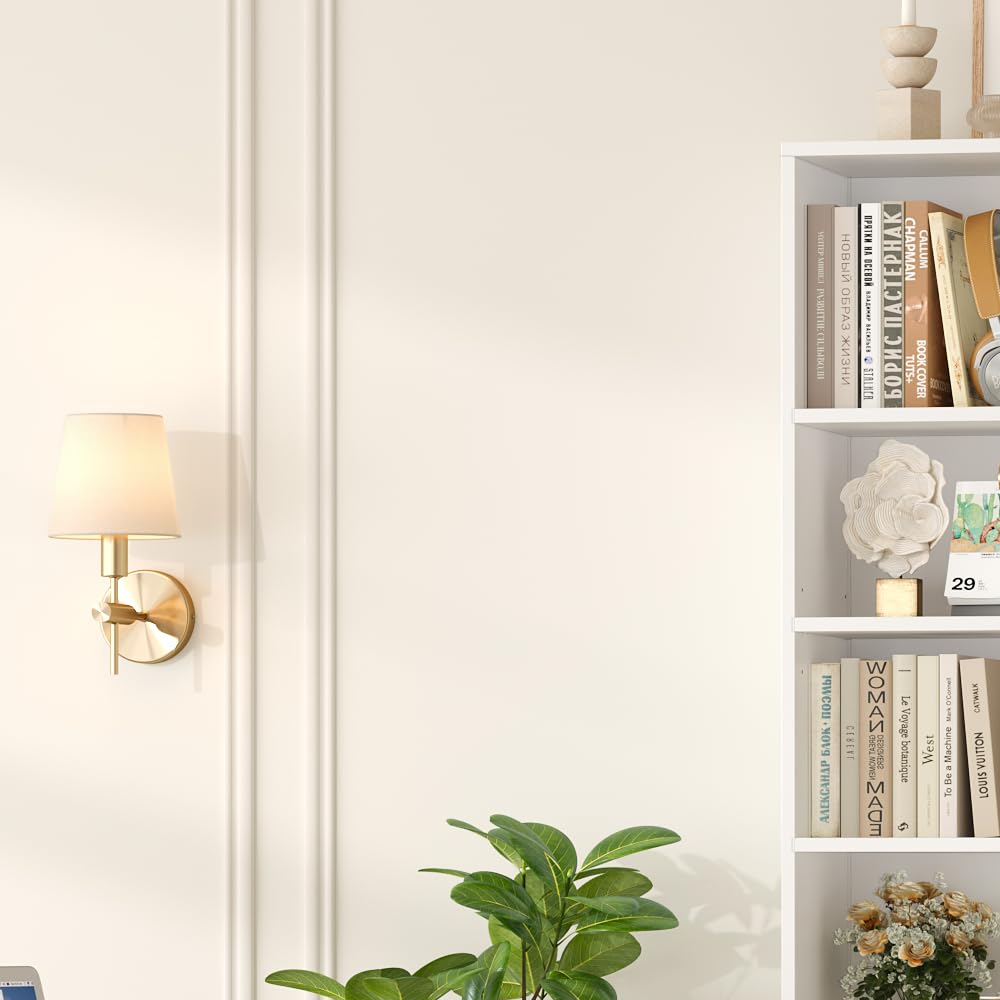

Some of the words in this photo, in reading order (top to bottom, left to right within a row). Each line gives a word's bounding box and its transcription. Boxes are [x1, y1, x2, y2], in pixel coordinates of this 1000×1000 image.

[863, 215, 874, 243] ПРЯТКИ
[841, 233, 852, 283] НОВЫЙ
[863, 246, 874, 256] НА
[904, 217, 917, 281] CHAPMAN
[918, 229, 929, 269] CALLUM
[863, 259, 874, 287] ОСЕВОЙ
[883, 211, 902, 329] ПАСТЕРНАК
[841, 287, 852, 330] ОБРАЗ
[841, 335, 852, 386] ЖИЗНИ
[883, 335, 902, 400] БОРИС
[904, 354, 915, 384] TUTS+
[916, 340, 927, 367] BOOK
[916, 368, 927, 399] COVER
[951, 577, 976, 591] 29
[821, 674, 833, 719] ПОЭМЫ
[900, 695, 912, 706] Le
[898, 707, 911, 739] Voyage
[944, 706, 952, 722] Mark
[820, 727, 832, 758] БЛОК
[921, 735, 935, 766] West
[944, 725, 953, 762] Machine
[974, 731, 987, 771] VUITTON
[898, 740, 911, 783] botanique
[818, 760, 831, 824] АЛЕКСАНДР
[944, 772, 953, 785] Be
[944, 786, 953, 798] To
[977, 771, 989, 799] LOUIS
